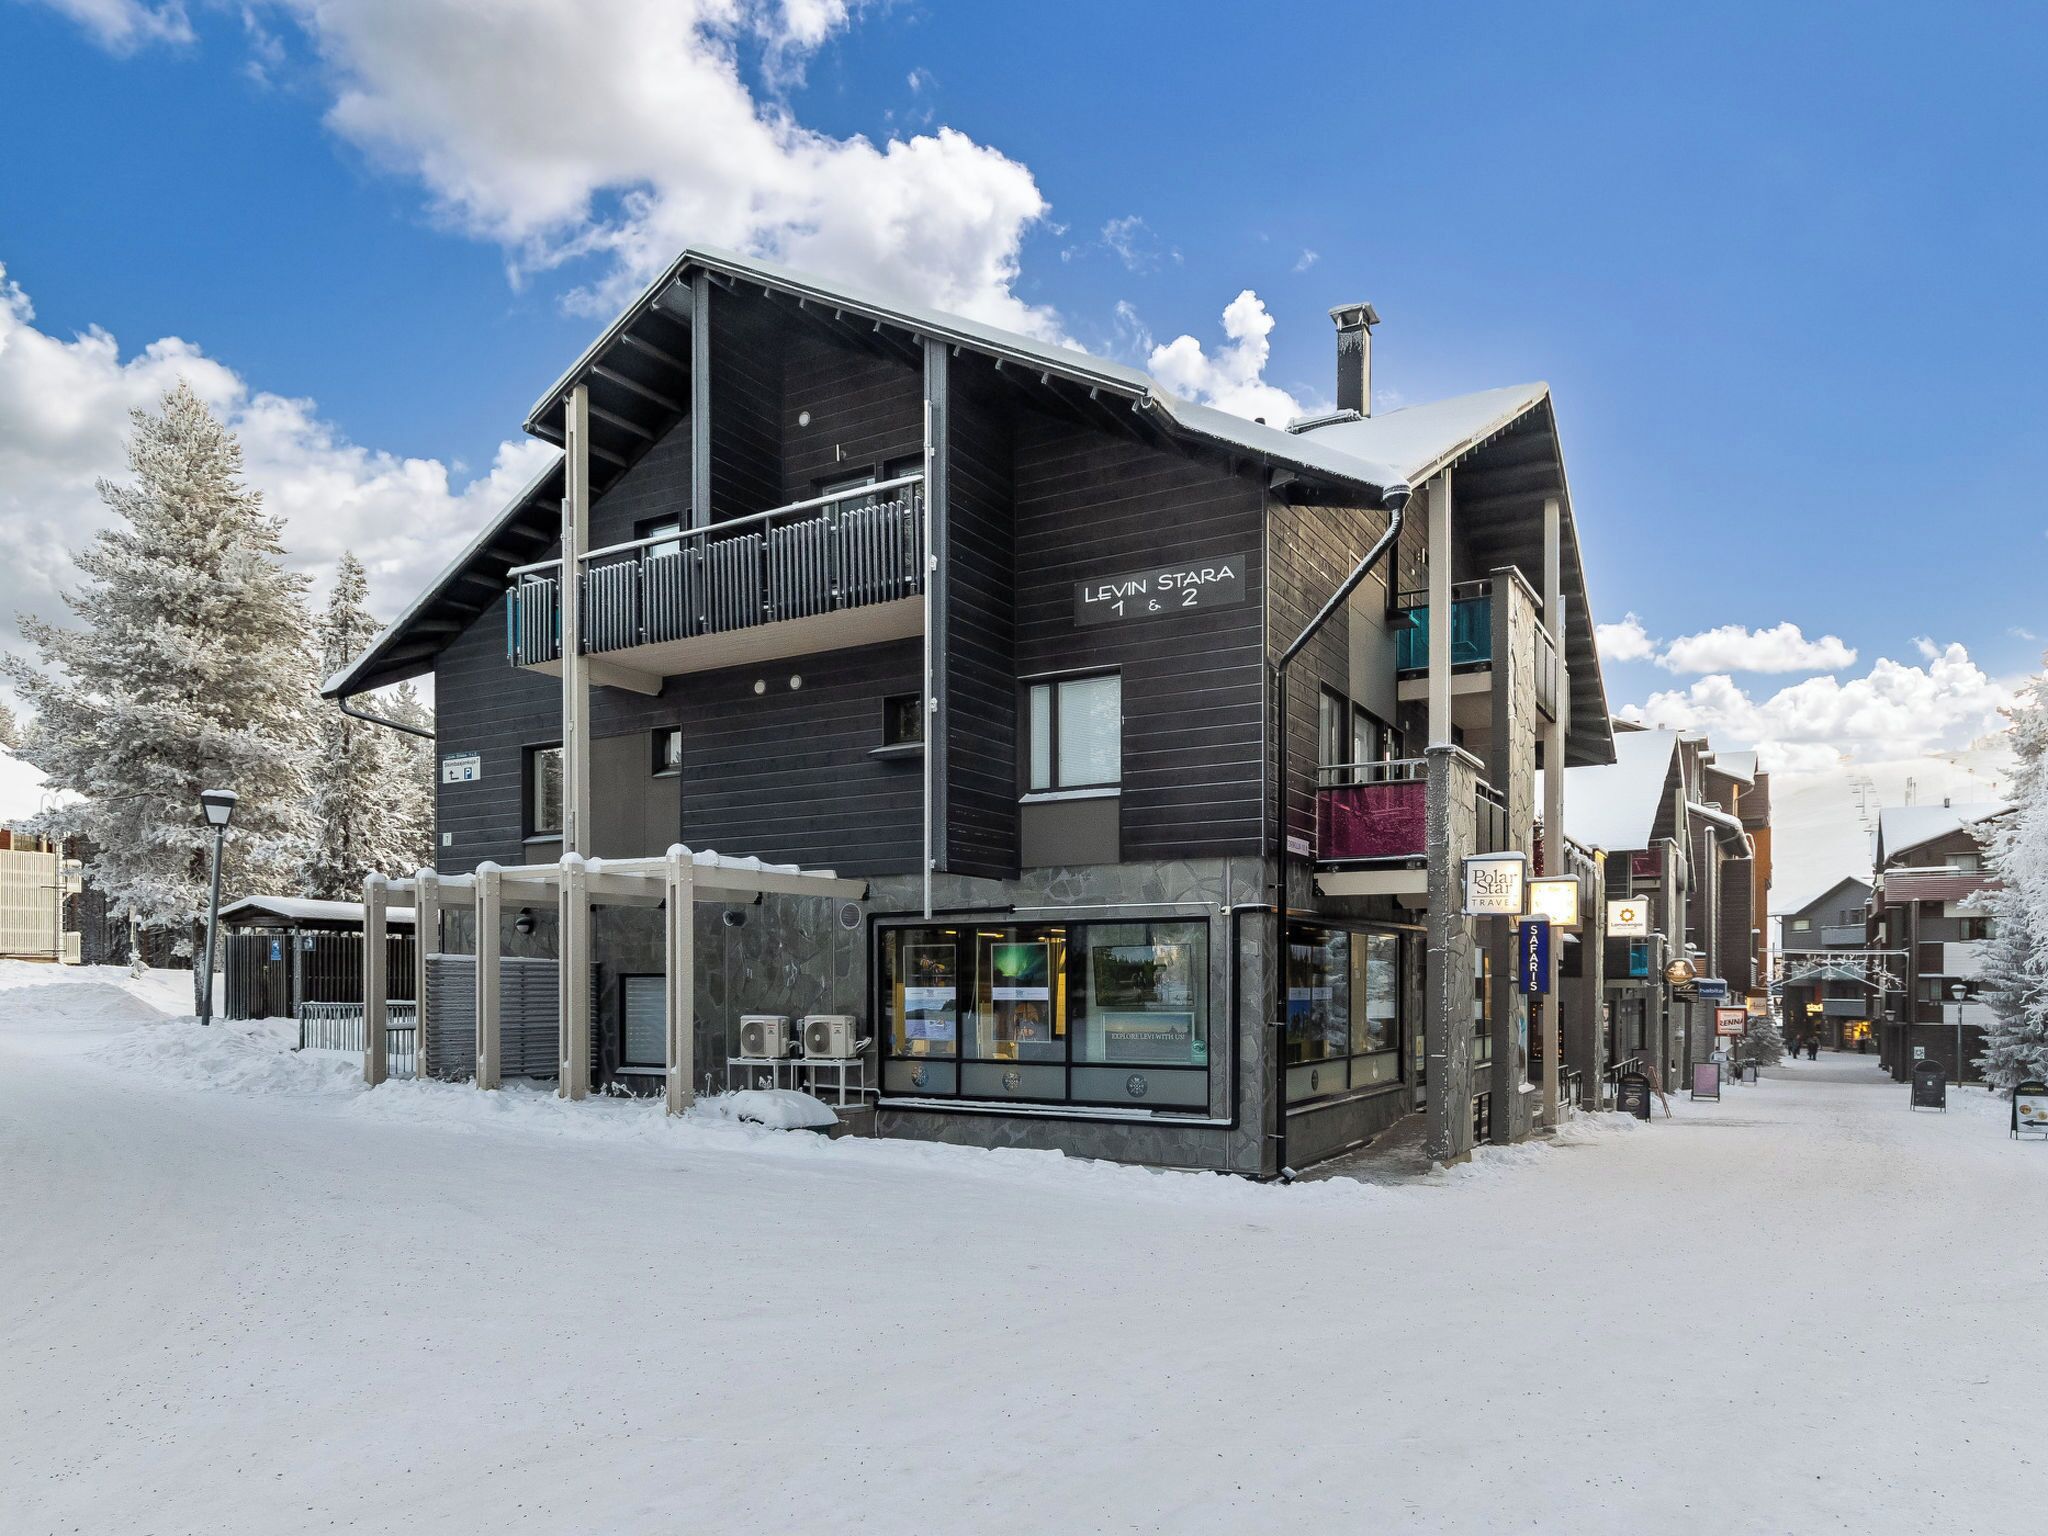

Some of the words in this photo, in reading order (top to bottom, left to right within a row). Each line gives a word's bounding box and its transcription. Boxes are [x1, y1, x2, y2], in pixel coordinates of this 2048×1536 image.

[1085, 579, 1147, 603] LEVIN
[1158, 566, 1235, 590] STARA
[1112, 600, 1124, 616] 1
[1148, 599, 1161, 611] &
[1182, 588, 1197, 607] 2
[1472, 869, 1518, 884] Polar
[1477, 879, 1512, 895] Star
[1530, 925, 1538, 992] SAFARIS
